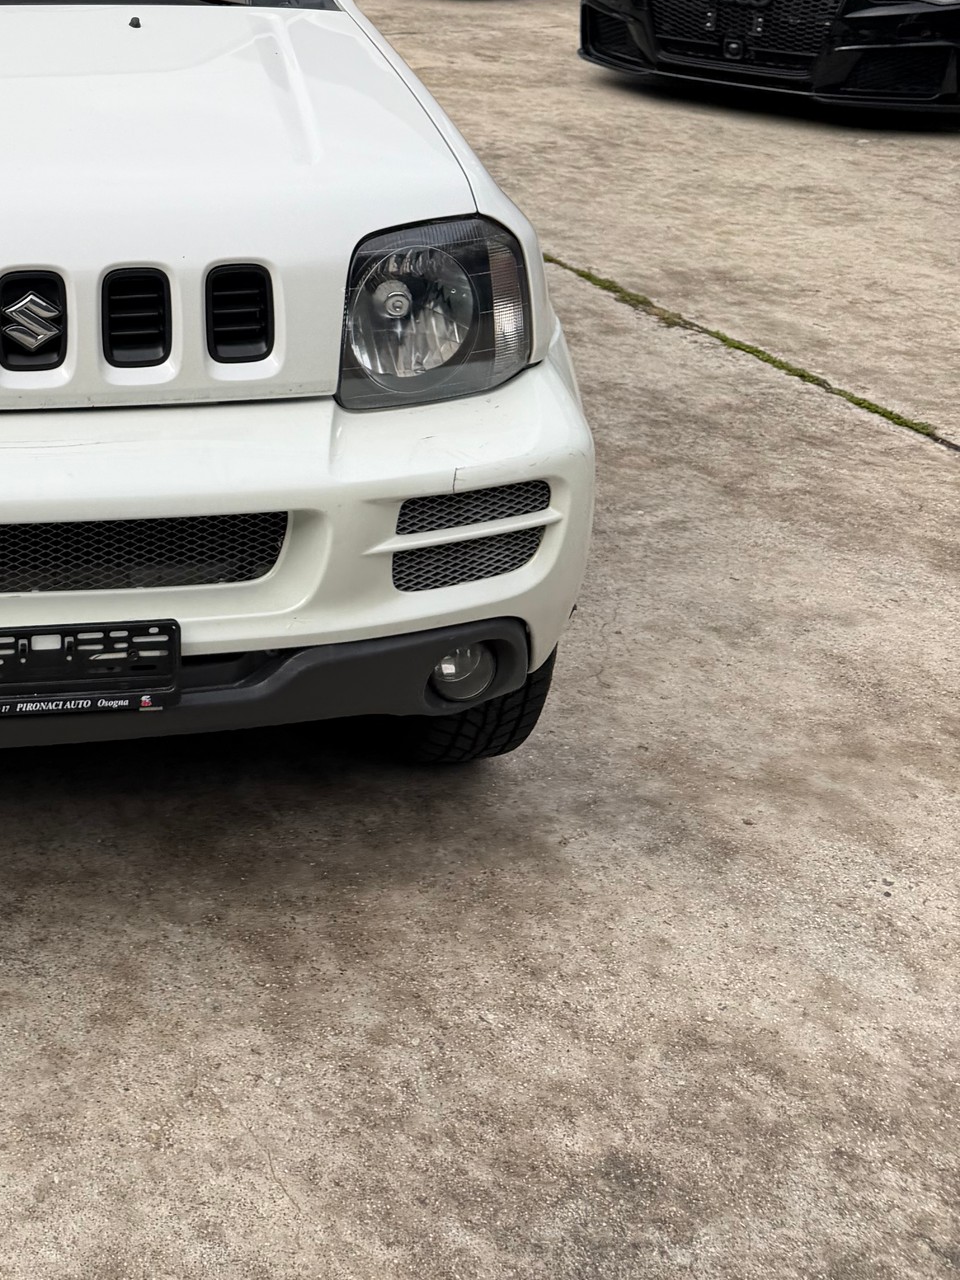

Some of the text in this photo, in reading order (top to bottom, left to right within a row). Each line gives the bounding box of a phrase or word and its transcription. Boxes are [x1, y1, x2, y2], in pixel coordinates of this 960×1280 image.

[1, 705, 11, 713] 17
[16, 701, 63, 712] PIRONACI
[64, 699, 92, 710] AUTO
[97, 698, 129, 708] Osogna
